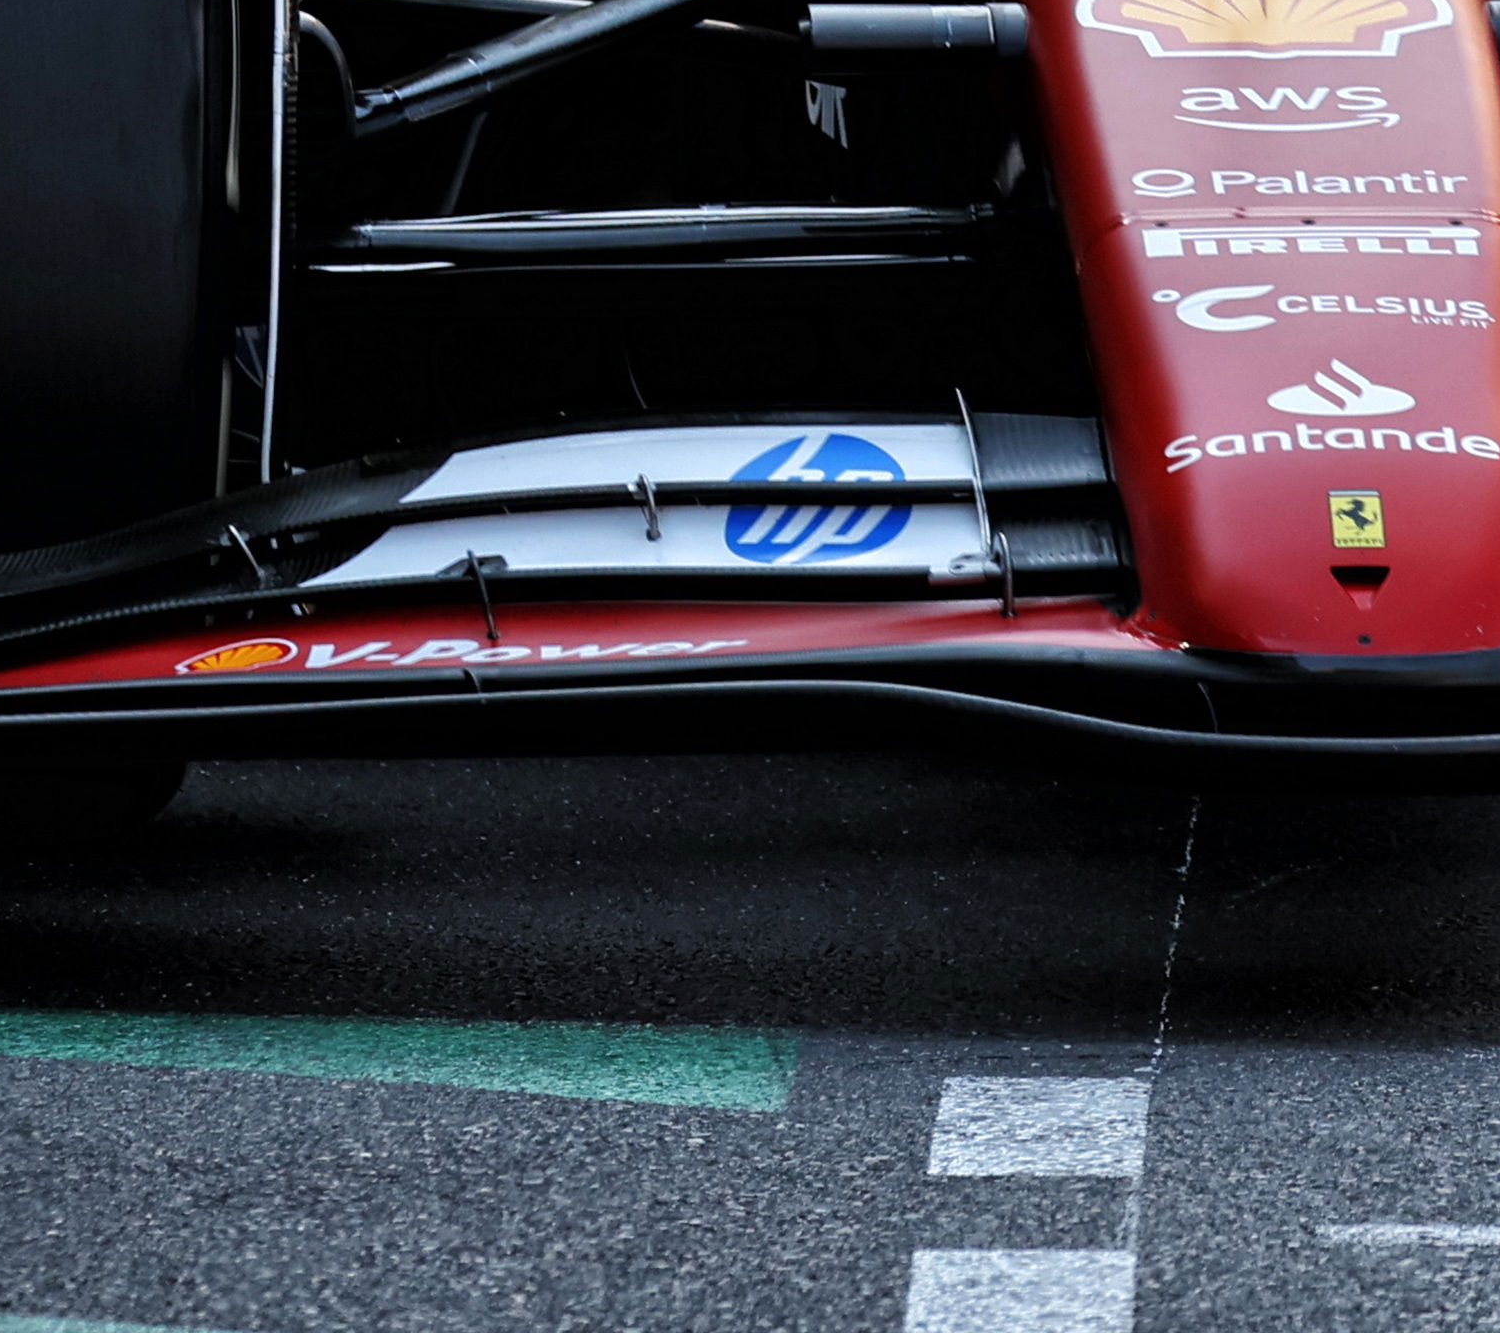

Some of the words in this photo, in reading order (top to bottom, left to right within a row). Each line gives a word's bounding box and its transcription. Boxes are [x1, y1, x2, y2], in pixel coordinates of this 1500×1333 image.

[1179, 85, 1389, 113] aws
[1211, 168, 1469, 195] Palantir
[1141, 226, 1482, 258] PIRELLI
[1411, 313, 1454, 326] LIVE
[1457, 316, 1493, 329] FIT
[736, 433, 900, 565] hp
[300, 636, 752, 670] V-Power
